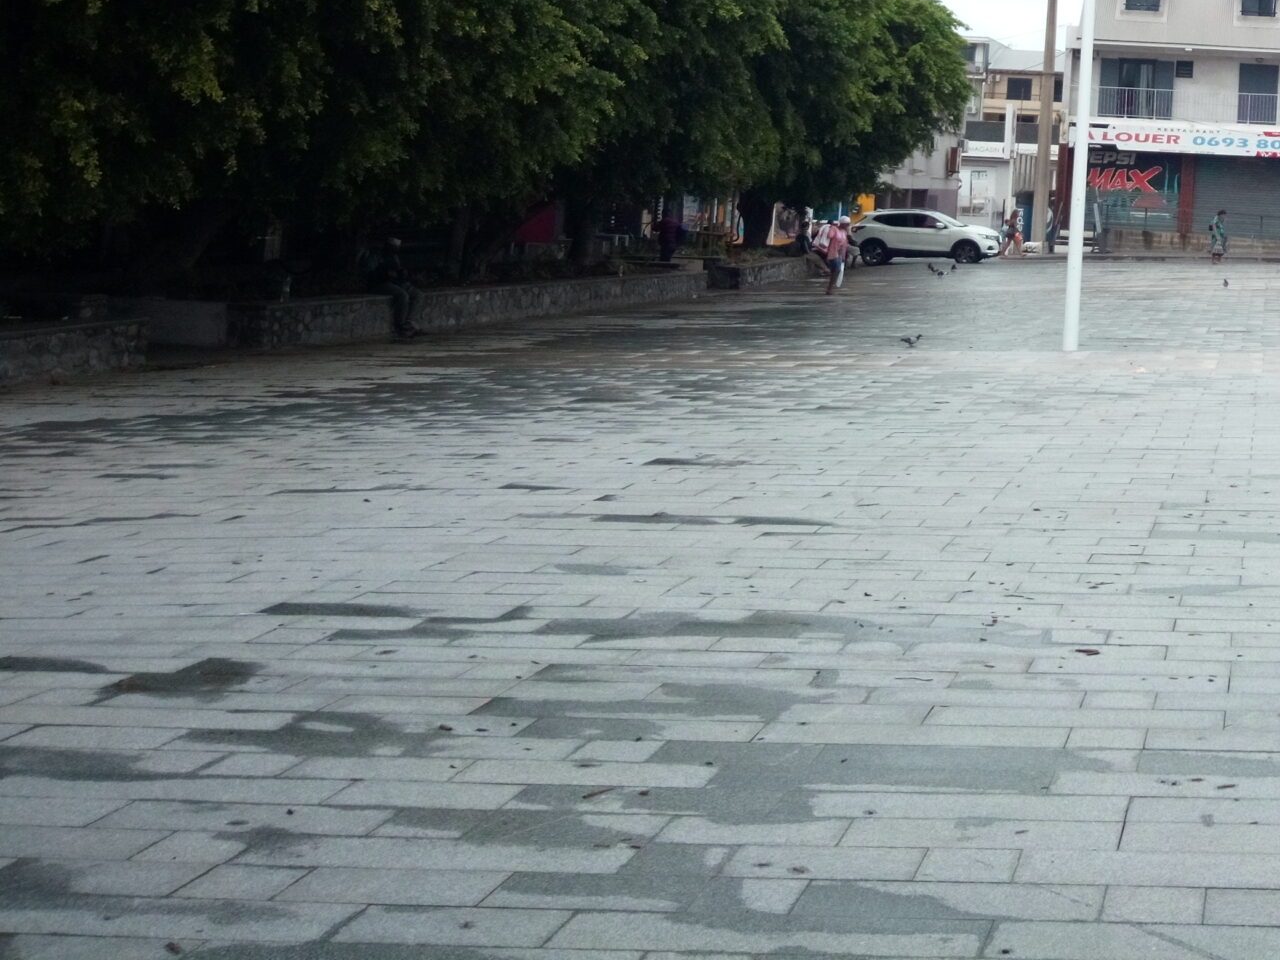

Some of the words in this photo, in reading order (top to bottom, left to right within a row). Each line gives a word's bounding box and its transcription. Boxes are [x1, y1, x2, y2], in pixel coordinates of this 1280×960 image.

[1102, 131, 1180, 145] LOUER
[1192, 135, 1249, 148] 0693
[1089, 150, 1137, 165] EPSI
[1087, 165, 1163, 194] MAX
